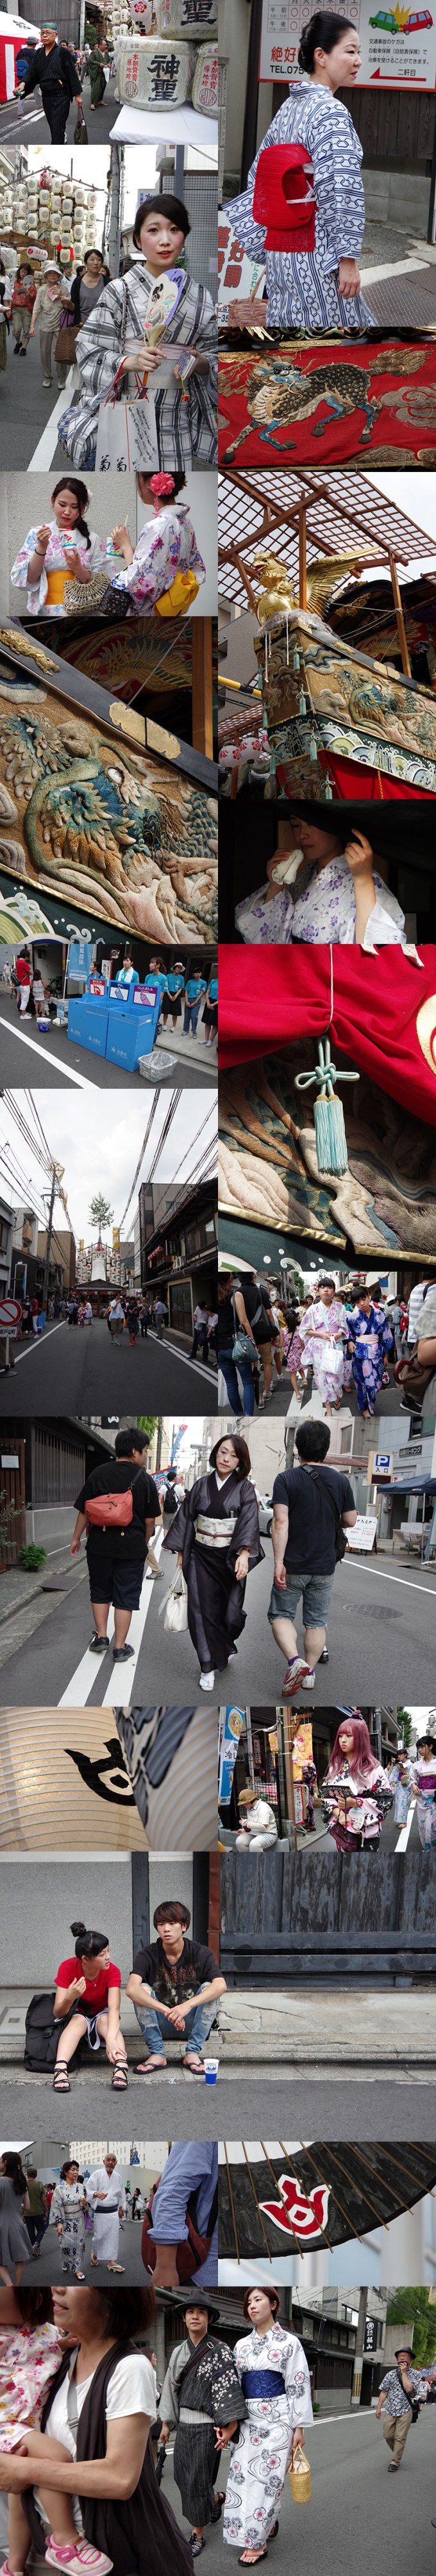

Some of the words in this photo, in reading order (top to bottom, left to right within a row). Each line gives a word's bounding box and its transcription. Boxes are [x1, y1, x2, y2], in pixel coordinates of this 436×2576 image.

[147, 54, 180, 102] 神聖
[271, 47, 301, 62] 絶好
[223, 232, 244, 288] 好調
